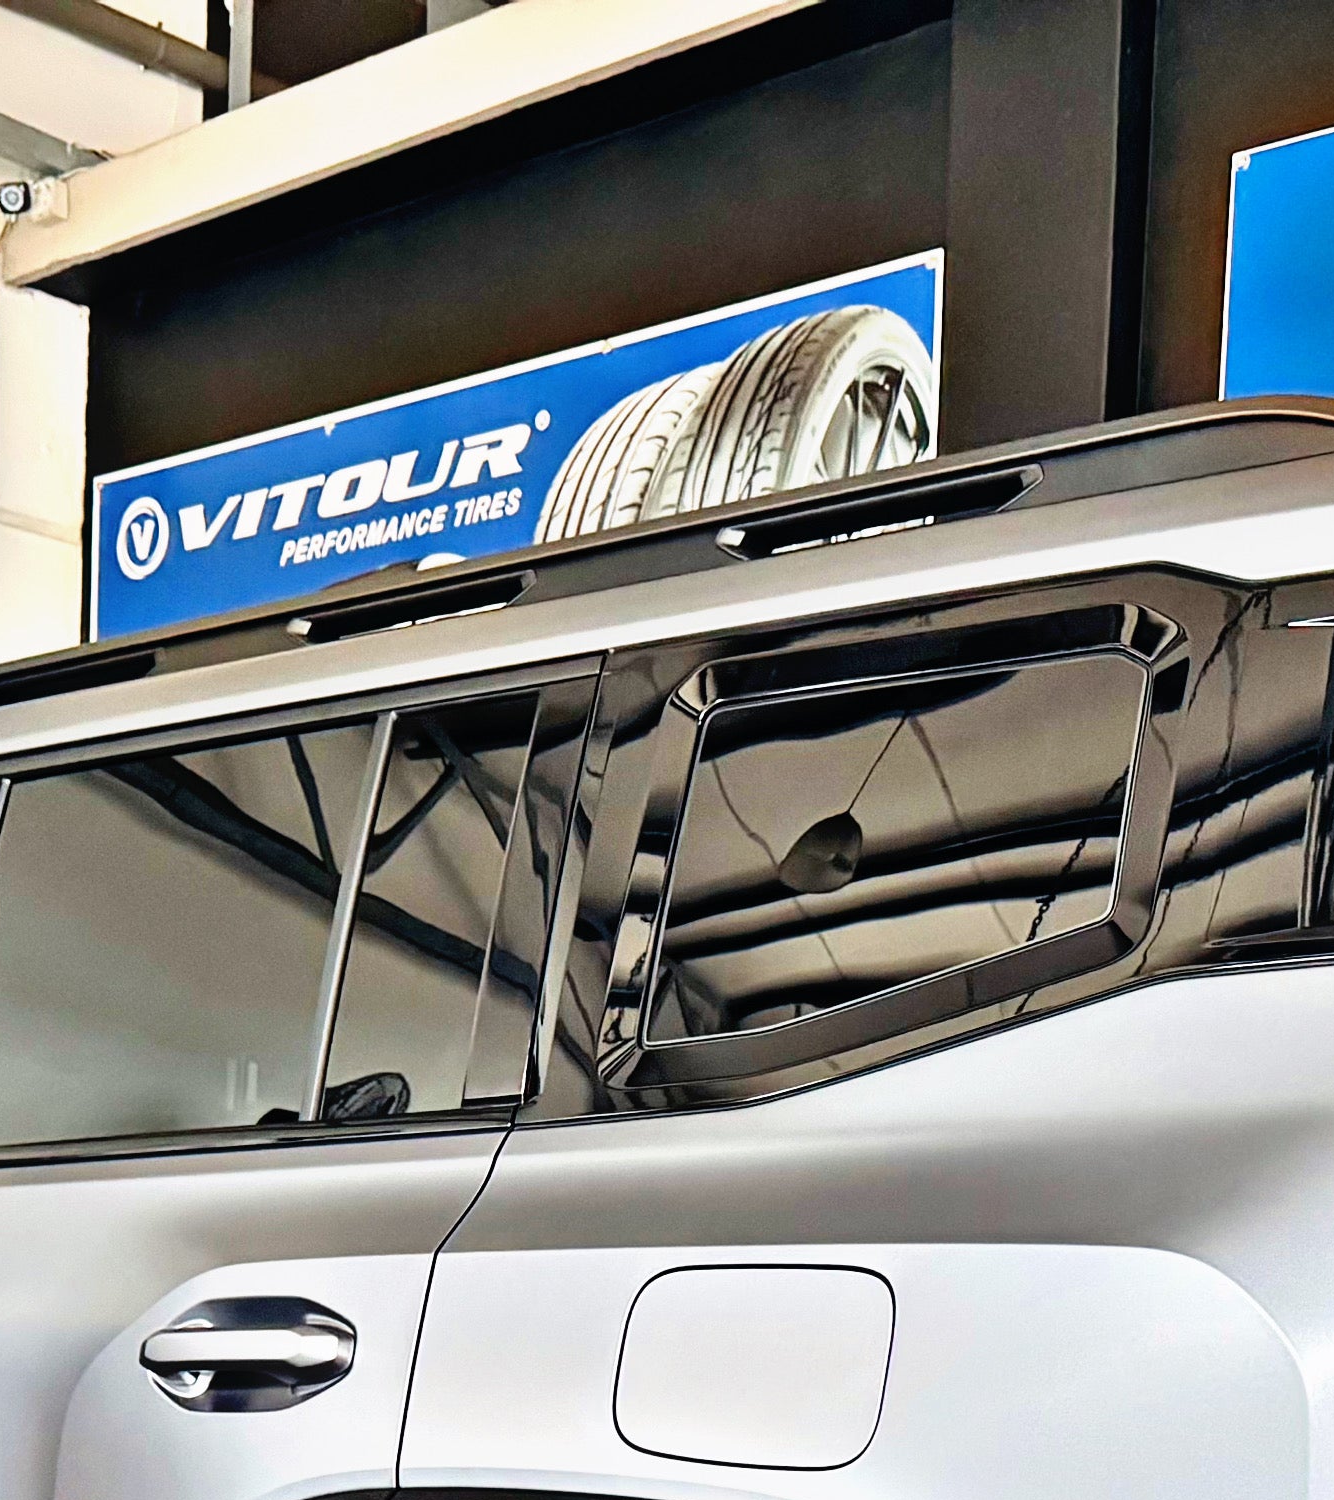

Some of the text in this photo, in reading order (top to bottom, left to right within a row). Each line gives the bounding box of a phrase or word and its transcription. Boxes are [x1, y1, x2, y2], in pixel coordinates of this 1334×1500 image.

[178, 423, 532, 551] VITOUR
[279, 488, 523, 566] PERFORMANCE TIRES
